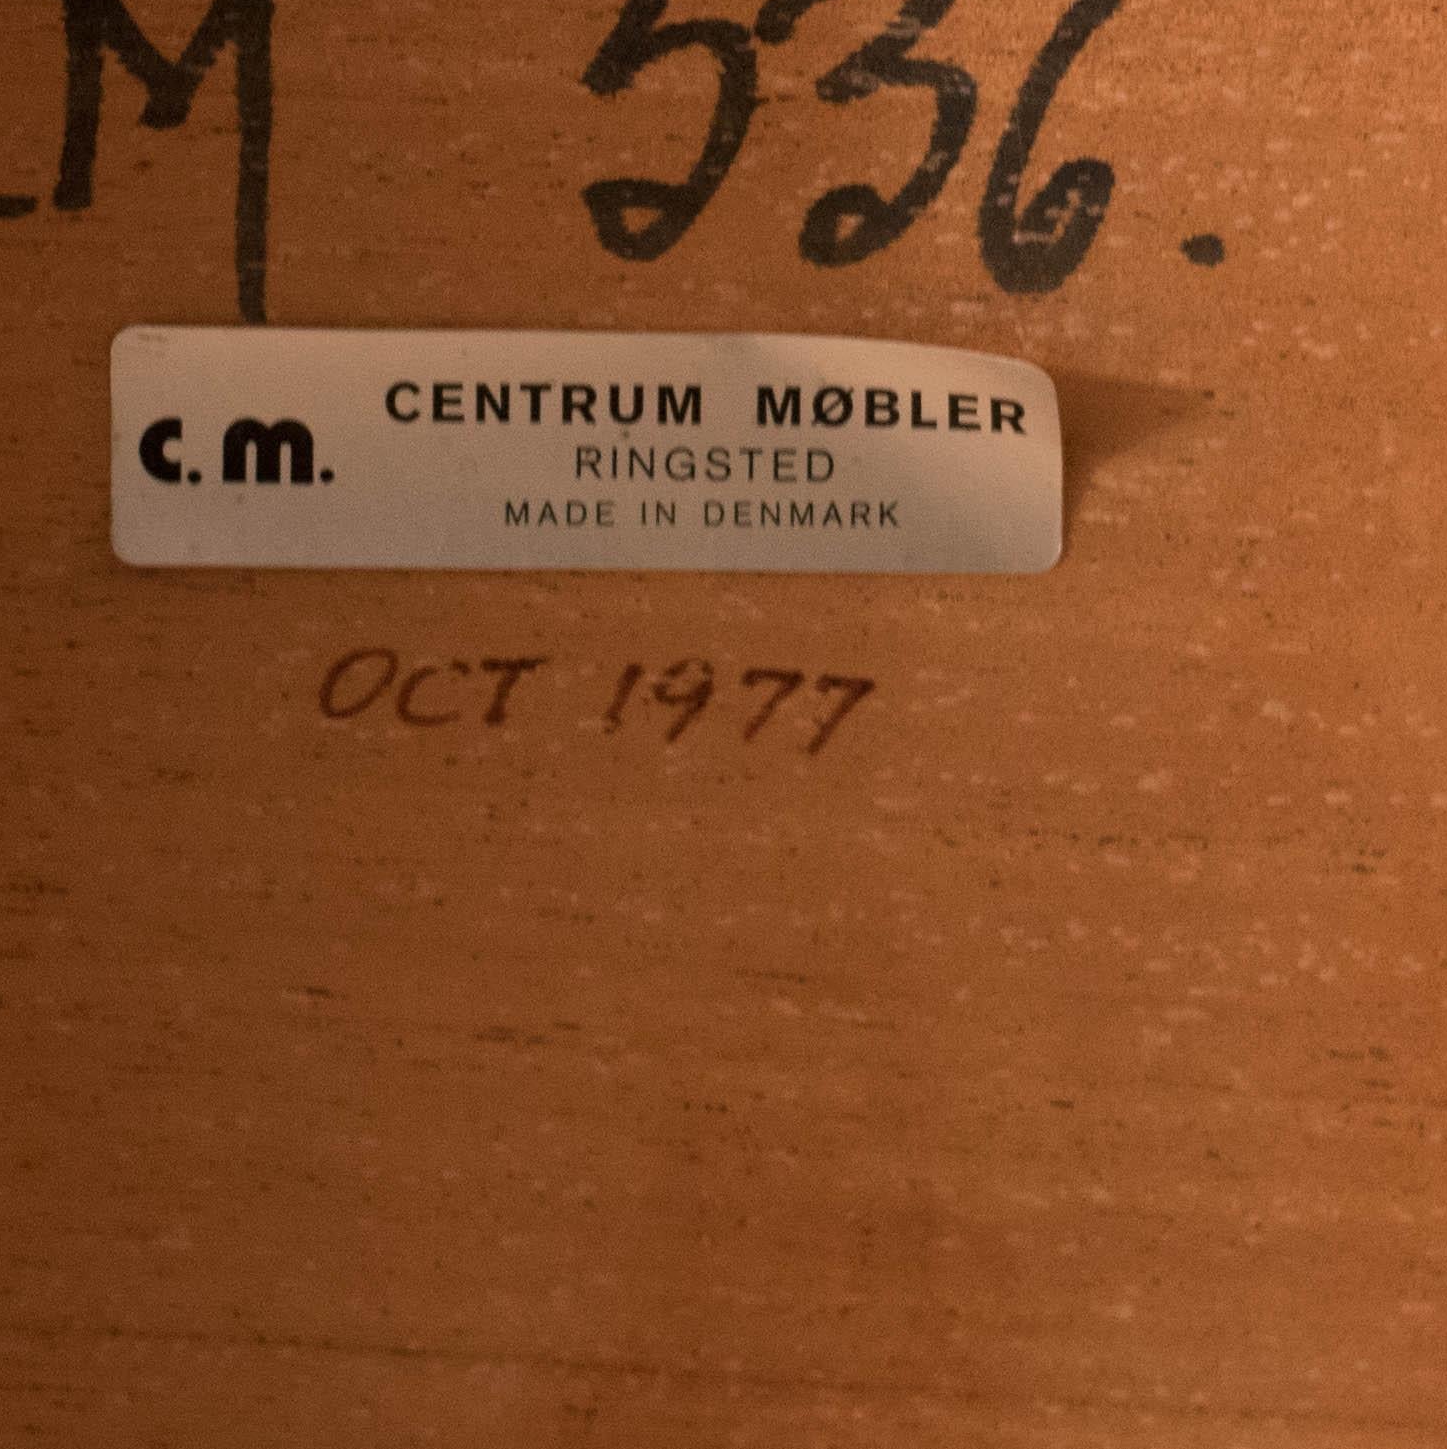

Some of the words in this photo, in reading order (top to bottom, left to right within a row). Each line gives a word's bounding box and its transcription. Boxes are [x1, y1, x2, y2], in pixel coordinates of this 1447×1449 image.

[384, 380, 705, 427] CENTRUM
[756, 382, 1028, 436] MØBLER
[574, 444, 836, 484] RINGSTED
[504, 498, 617, 529] MADE
[640, 498, 676, 529] IN
[702, 498, 903, 530] DENMARK
[318, 647, 549, 726] OCT
[604, 658, 877, 756] 1977
